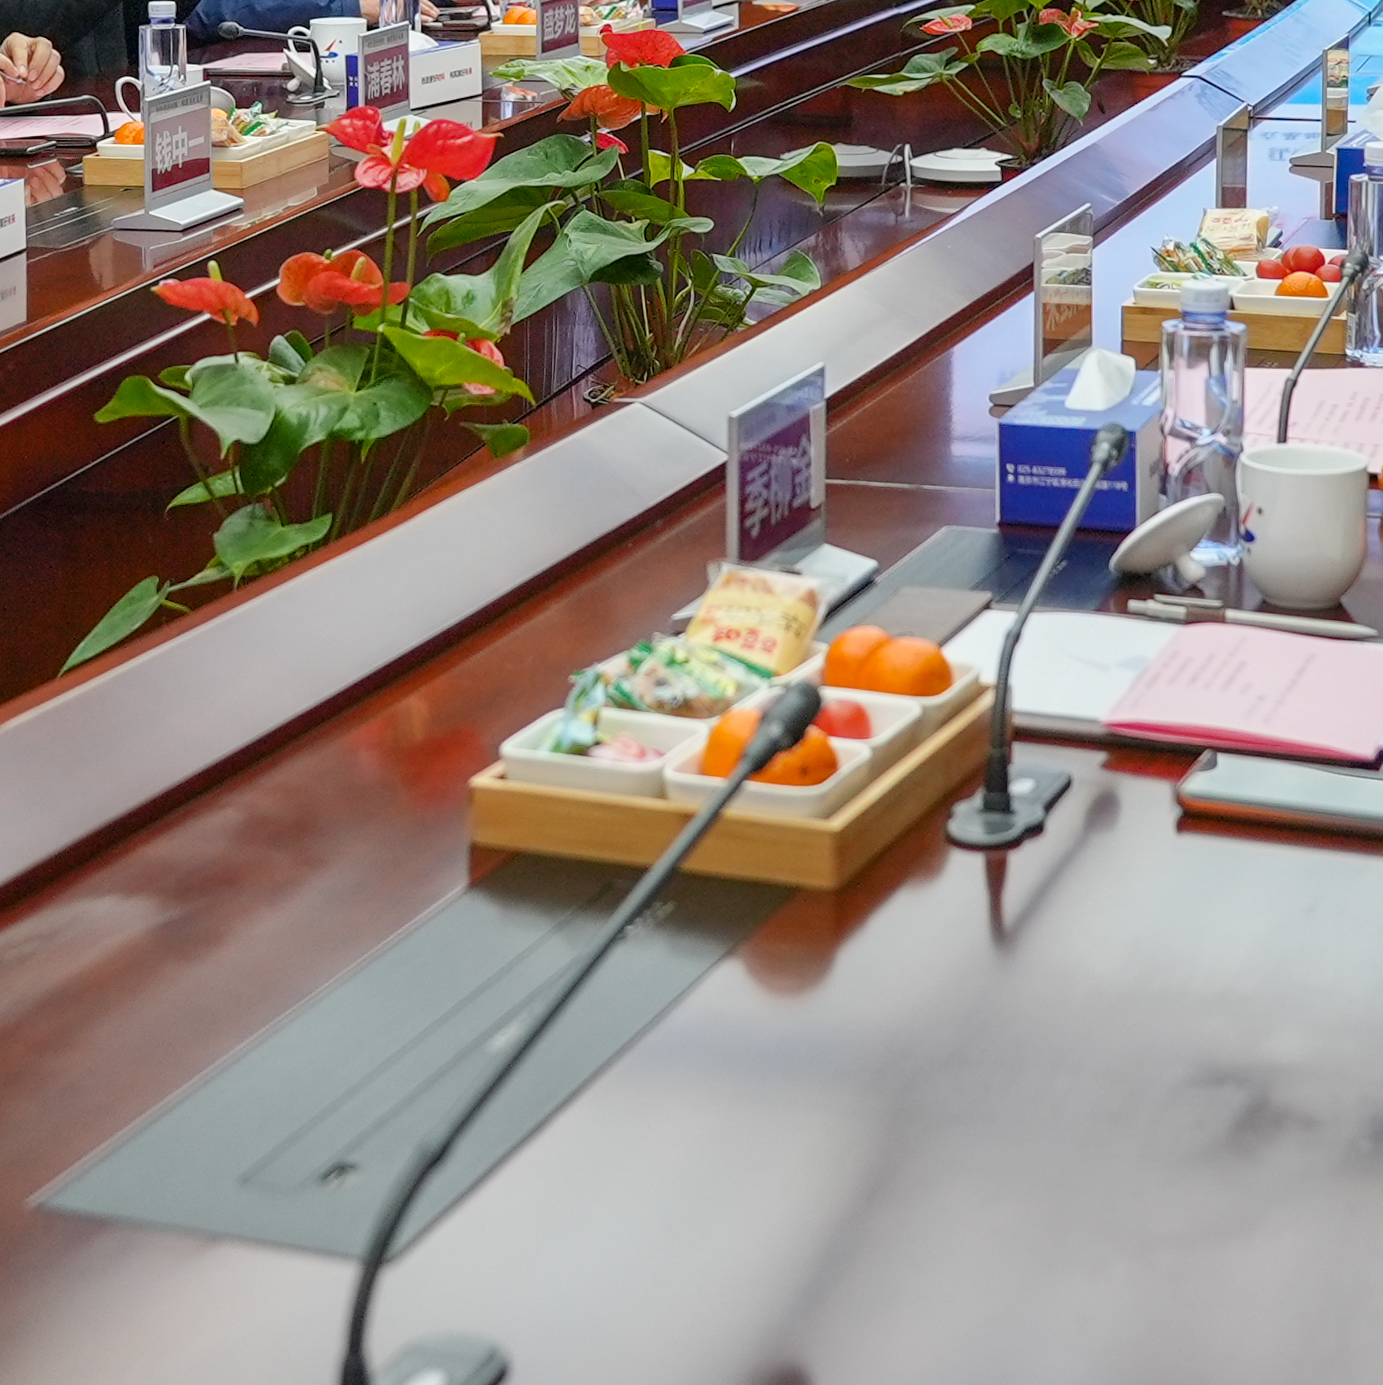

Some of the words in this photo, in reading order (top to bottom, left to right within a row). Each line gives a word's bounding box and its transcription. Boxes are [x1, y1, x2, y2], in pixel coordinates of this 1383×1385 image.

[543, 3, 577, 41] 盛梦龙
[366, 54, 405, 100] 浦春林
[155, 125, 205, 175] 钱中一
